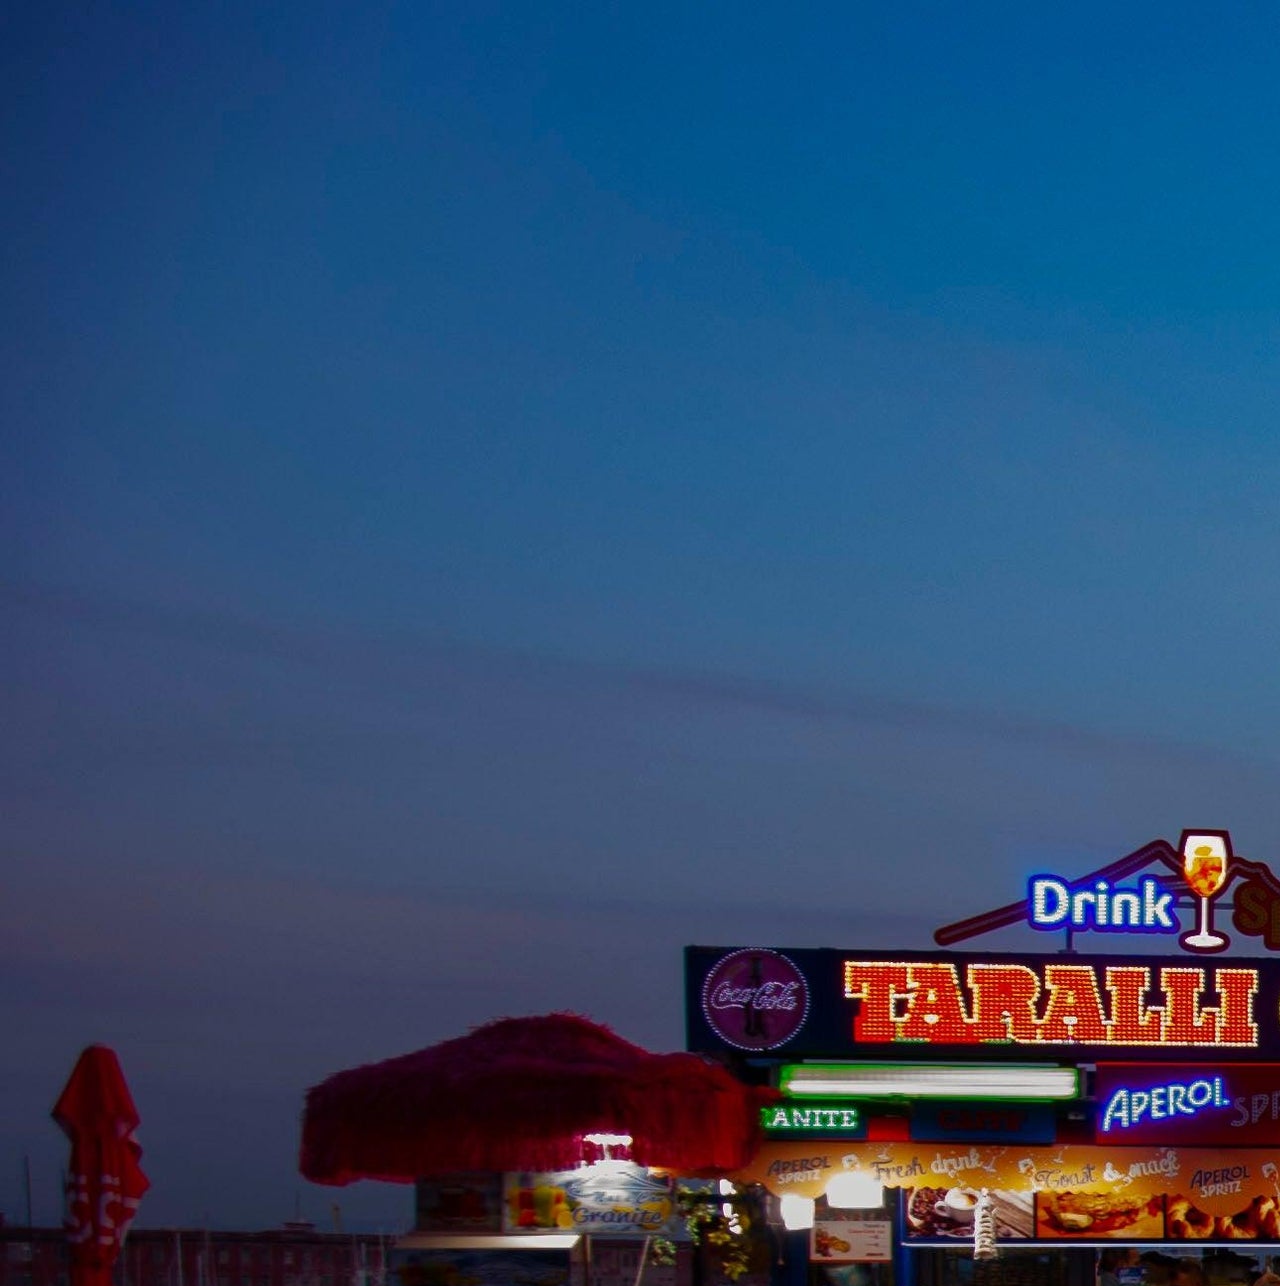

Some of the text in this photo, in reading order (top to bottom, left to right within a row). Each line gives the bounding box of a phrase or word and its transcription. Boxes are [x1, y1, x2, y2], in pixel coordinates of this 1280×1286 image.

[1033, 879, 1173, 927] Drink
[844, 961, 1259, 1047] TARALLI
[1102, 1076, 1231, 1132] APEROL
[763, 1107, 857, 1127] ANITE
[767, 1156, 832, 1177] APEROL
[869, 1157, 927, 1180] Fresh
[1190, 1165, 1250, 1189] APEROL
[572, 1207, 664, 1225] Granite
